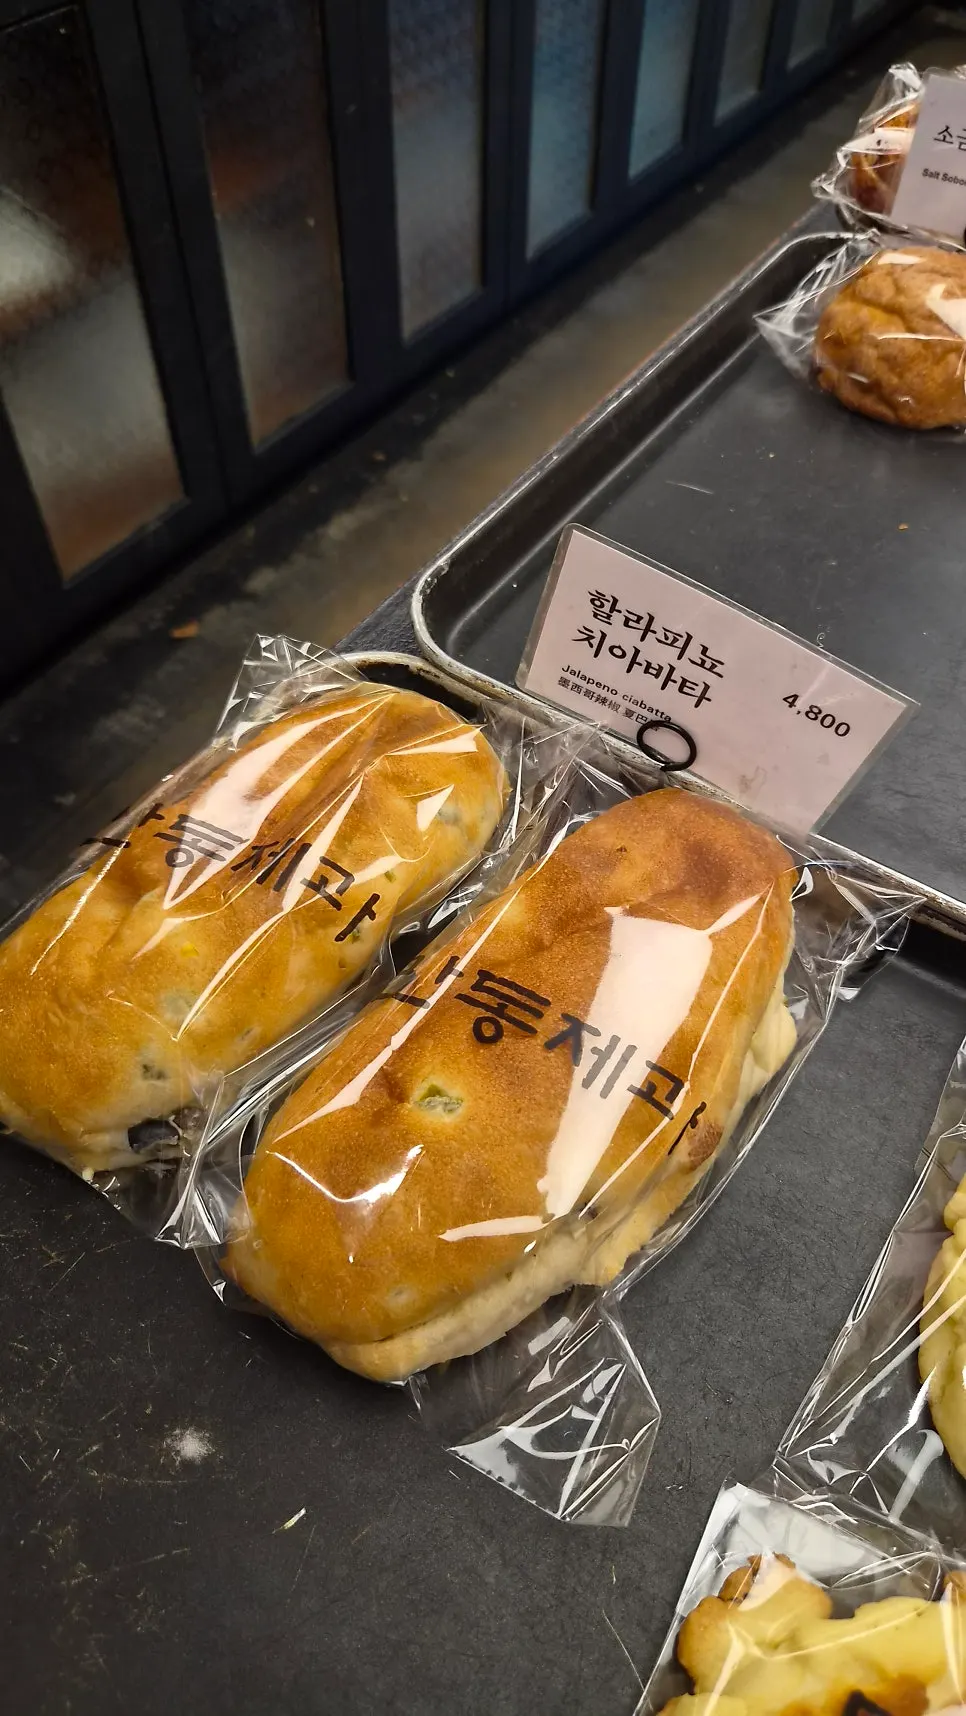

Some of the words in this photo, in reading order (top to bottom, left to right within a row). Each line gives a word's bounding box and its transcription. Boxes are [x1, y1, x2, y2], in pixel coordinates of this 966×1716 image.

[922, 168, 940, 180] Salt
[587, 589, 725, 679] 할라피뇨
[561, 664, 619, 697] Jalapeno
[622, 693, 673, 723] ciabatta
[572, 625, 712, 709] 치아바타
[622, 707, 662, 732] 夏巴
[782, 692, 852, 739] 4,800
